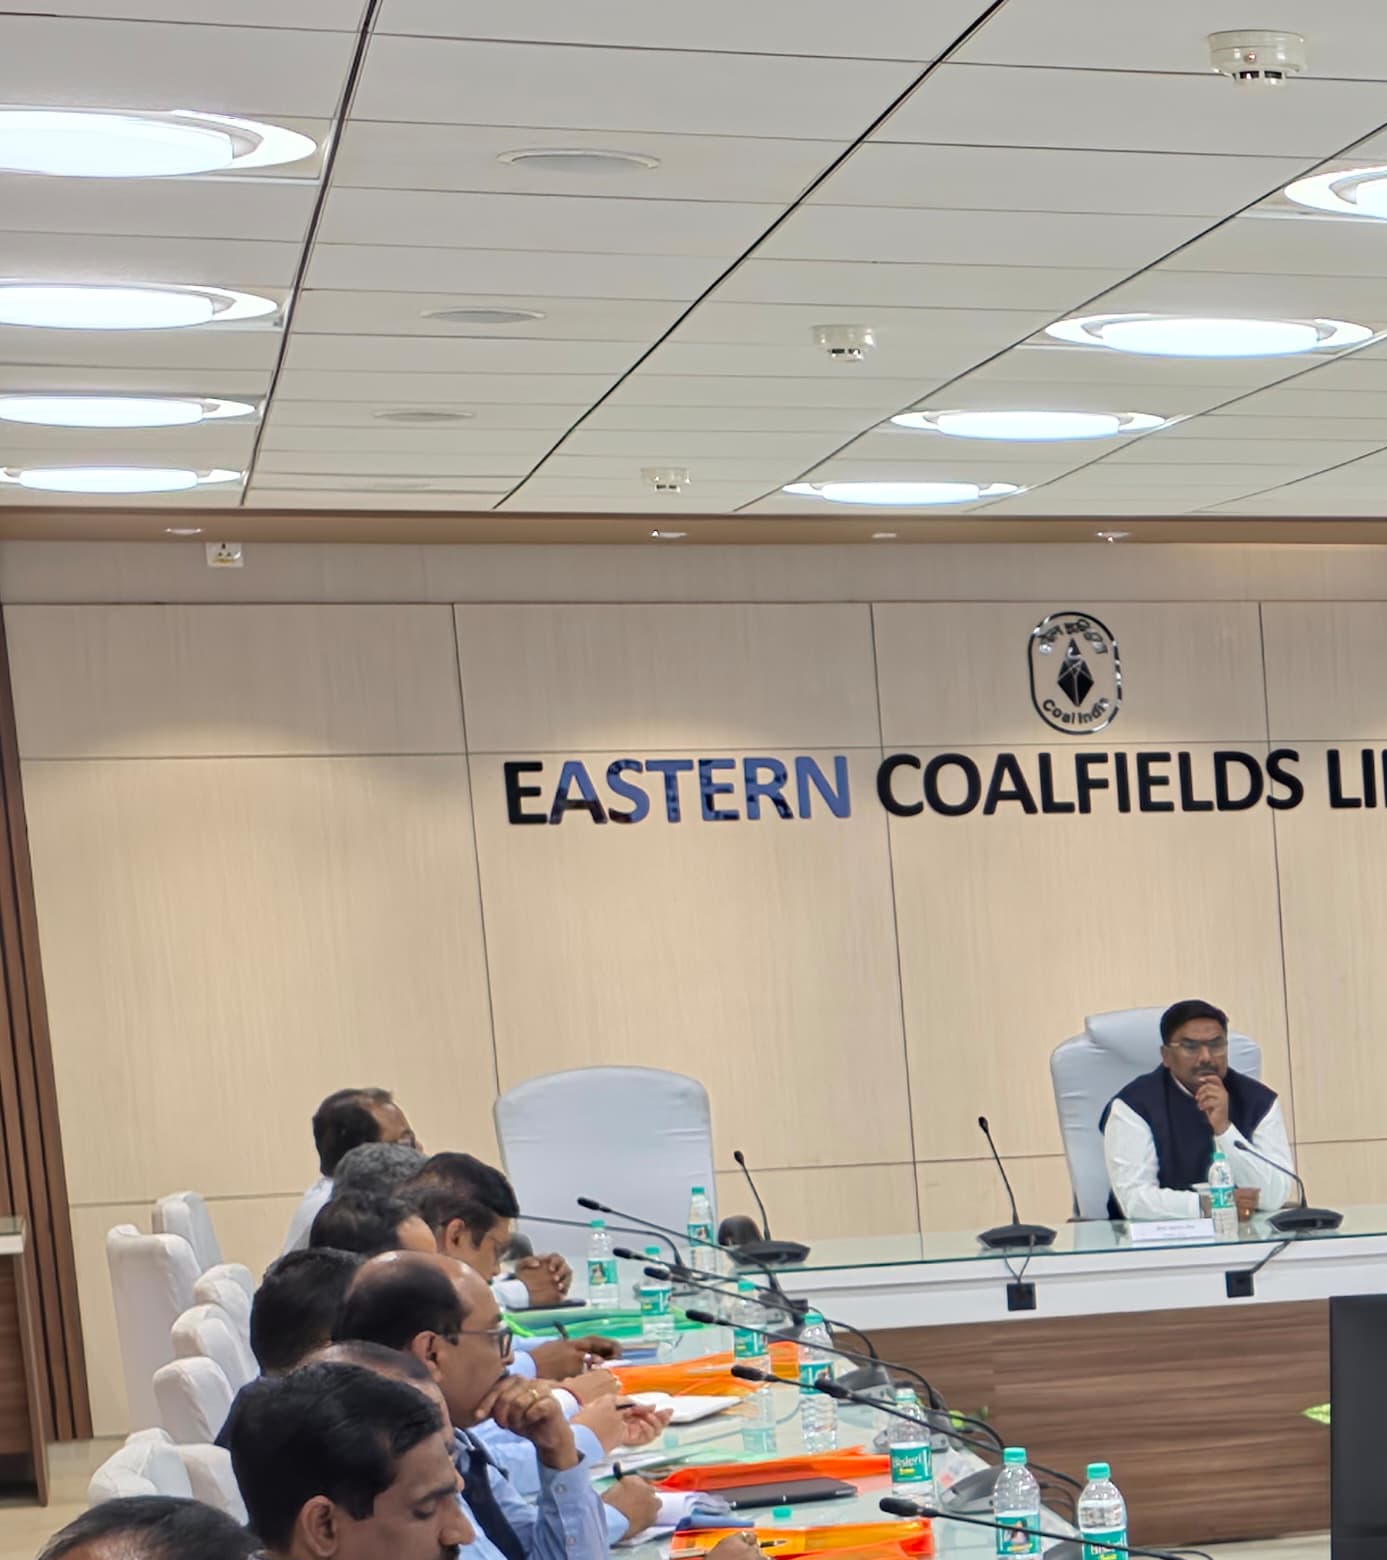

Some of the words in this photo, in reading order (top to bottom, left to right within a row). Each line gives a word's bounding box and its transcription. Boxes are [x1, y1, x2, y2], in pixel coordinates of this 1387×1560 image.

[1042, 698, 1076, 725] Coal
[504, 757, 851, 825] EASTERN
[876, 747, 1304, 816] COALFIELDS
